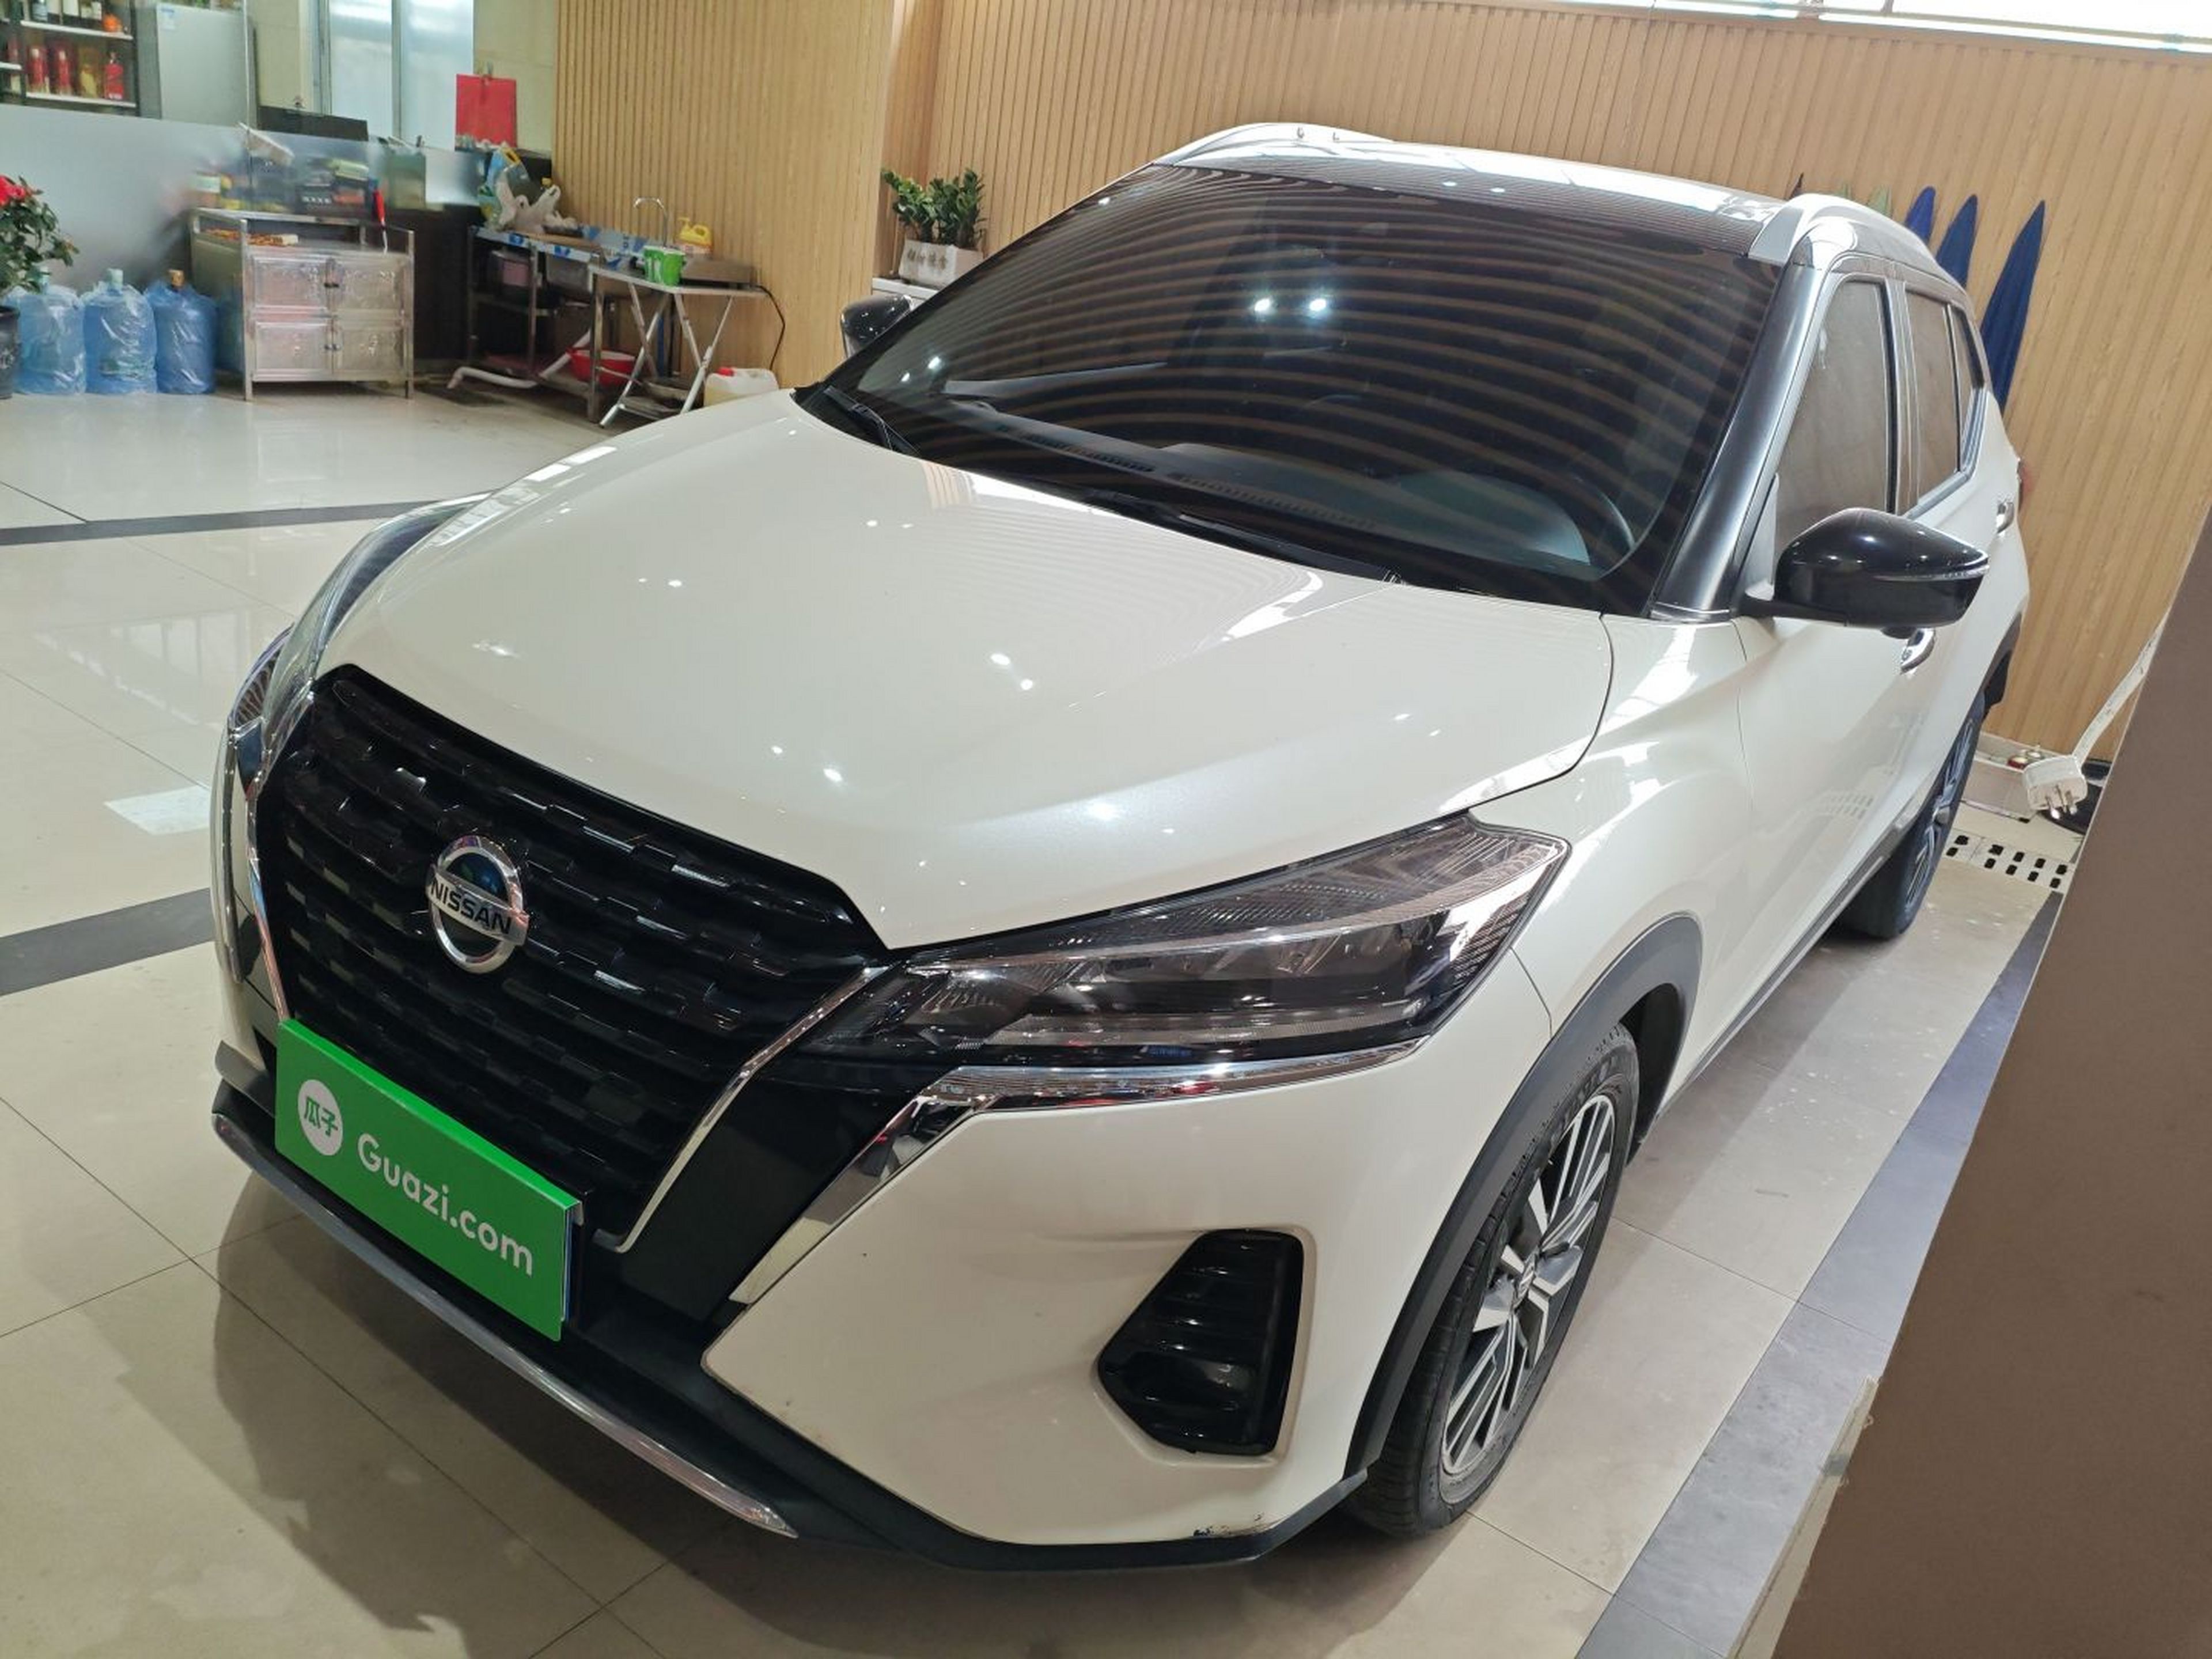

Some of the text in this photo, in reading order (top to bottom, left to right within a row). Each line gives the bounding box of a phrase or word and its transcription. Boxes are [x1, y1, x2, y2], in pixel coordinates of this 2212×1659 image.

[430, 877, 512, 934] NISSAN
[304, 1096, 338, 1137] 瓜子
[357, 1133, 532, 1277] Guazi.com
